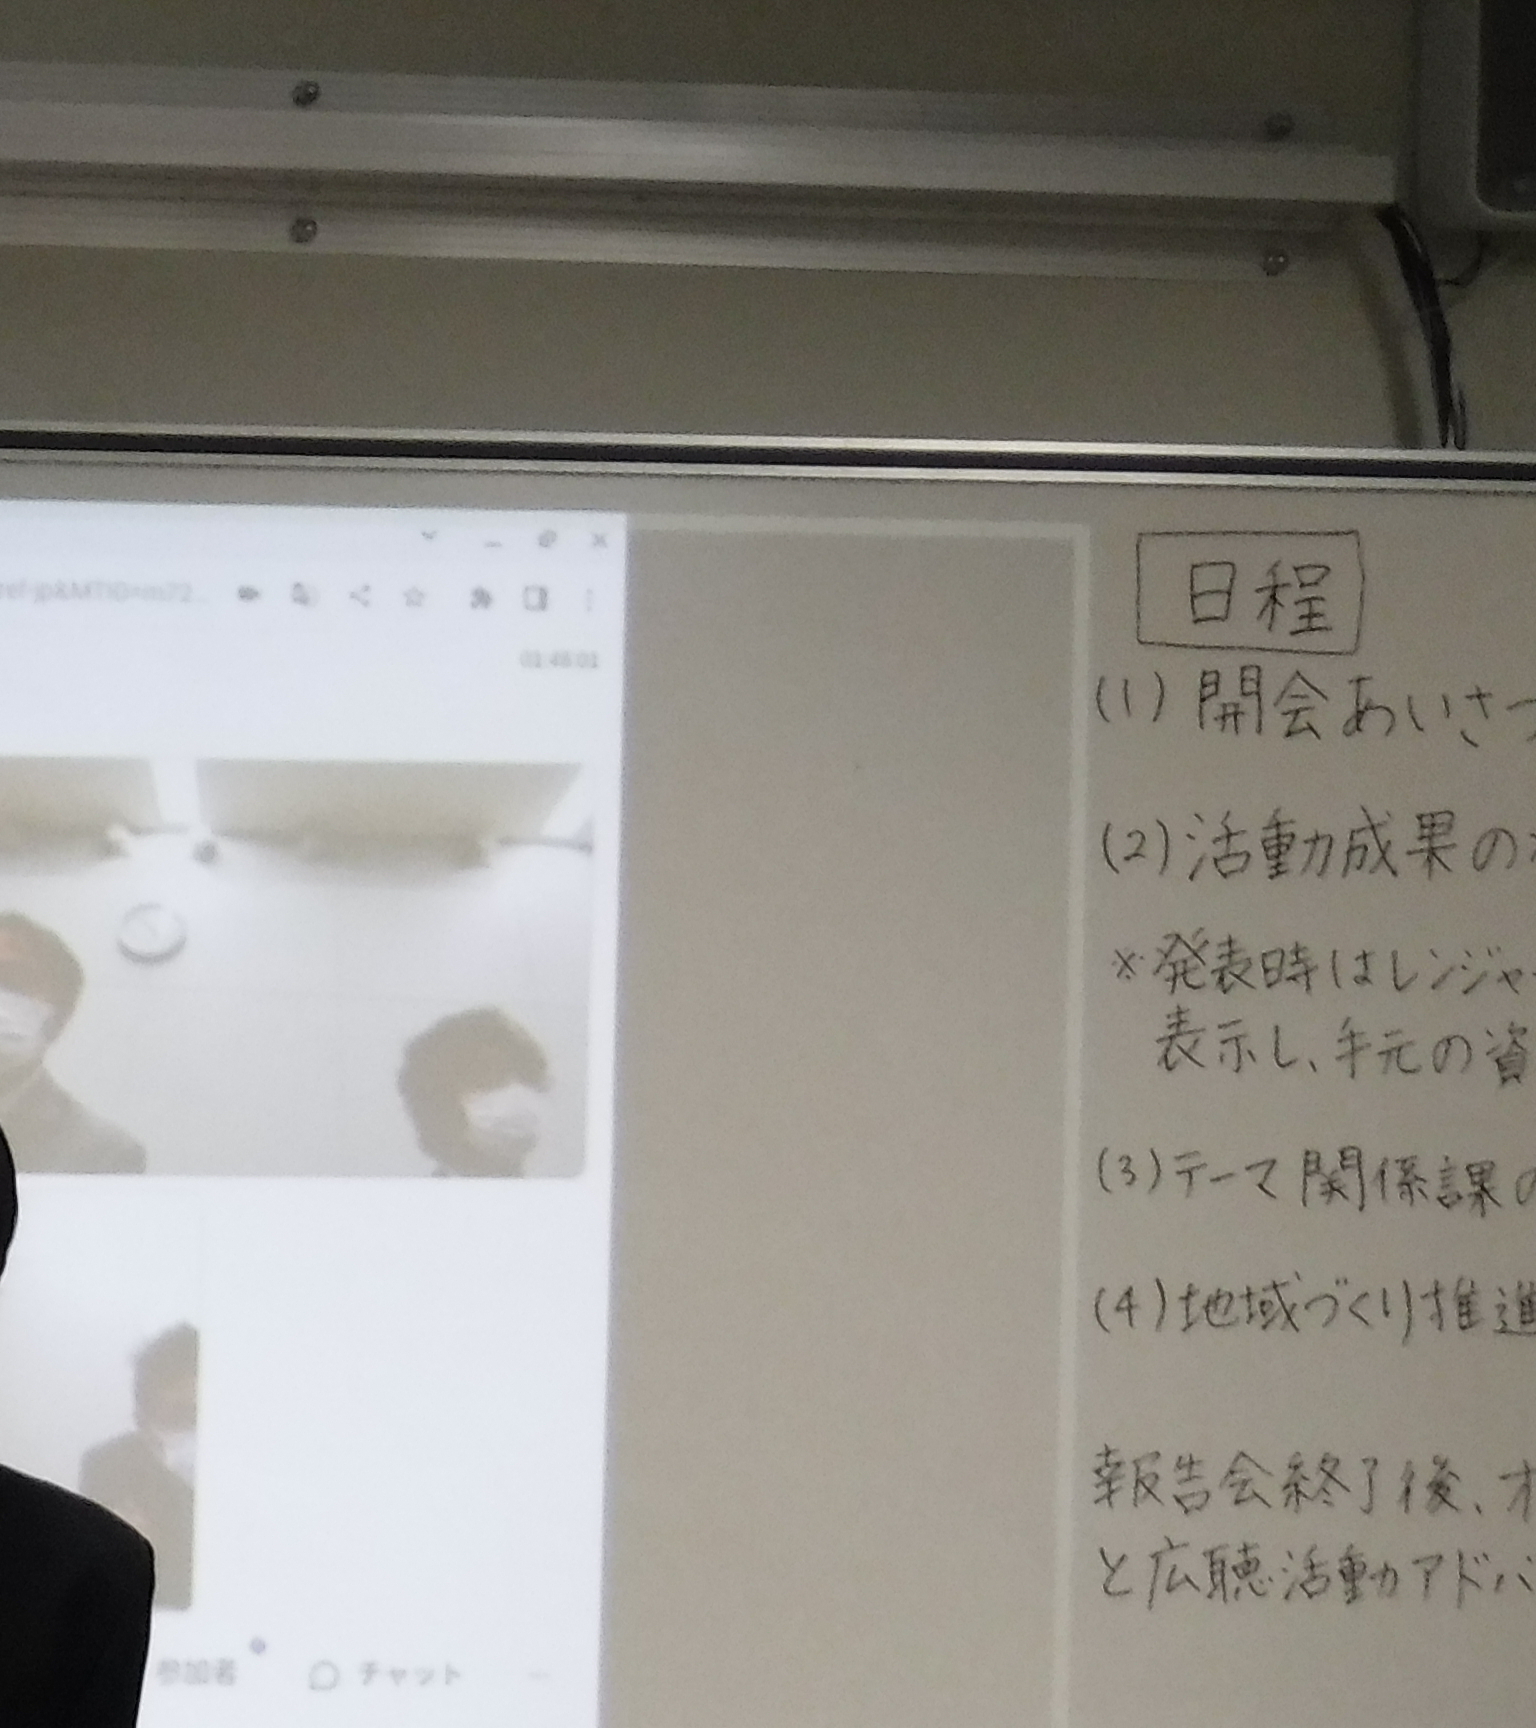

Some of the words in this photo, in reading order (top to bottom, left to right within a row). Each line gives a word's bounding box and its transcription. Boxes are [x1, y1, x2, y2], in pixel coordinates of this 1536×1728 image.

[1188, 558, 1335, 638] 日程
[1102, 802, 1536, 884] (2)活動成果の
[357, 1661, 463, 1687] チャット
